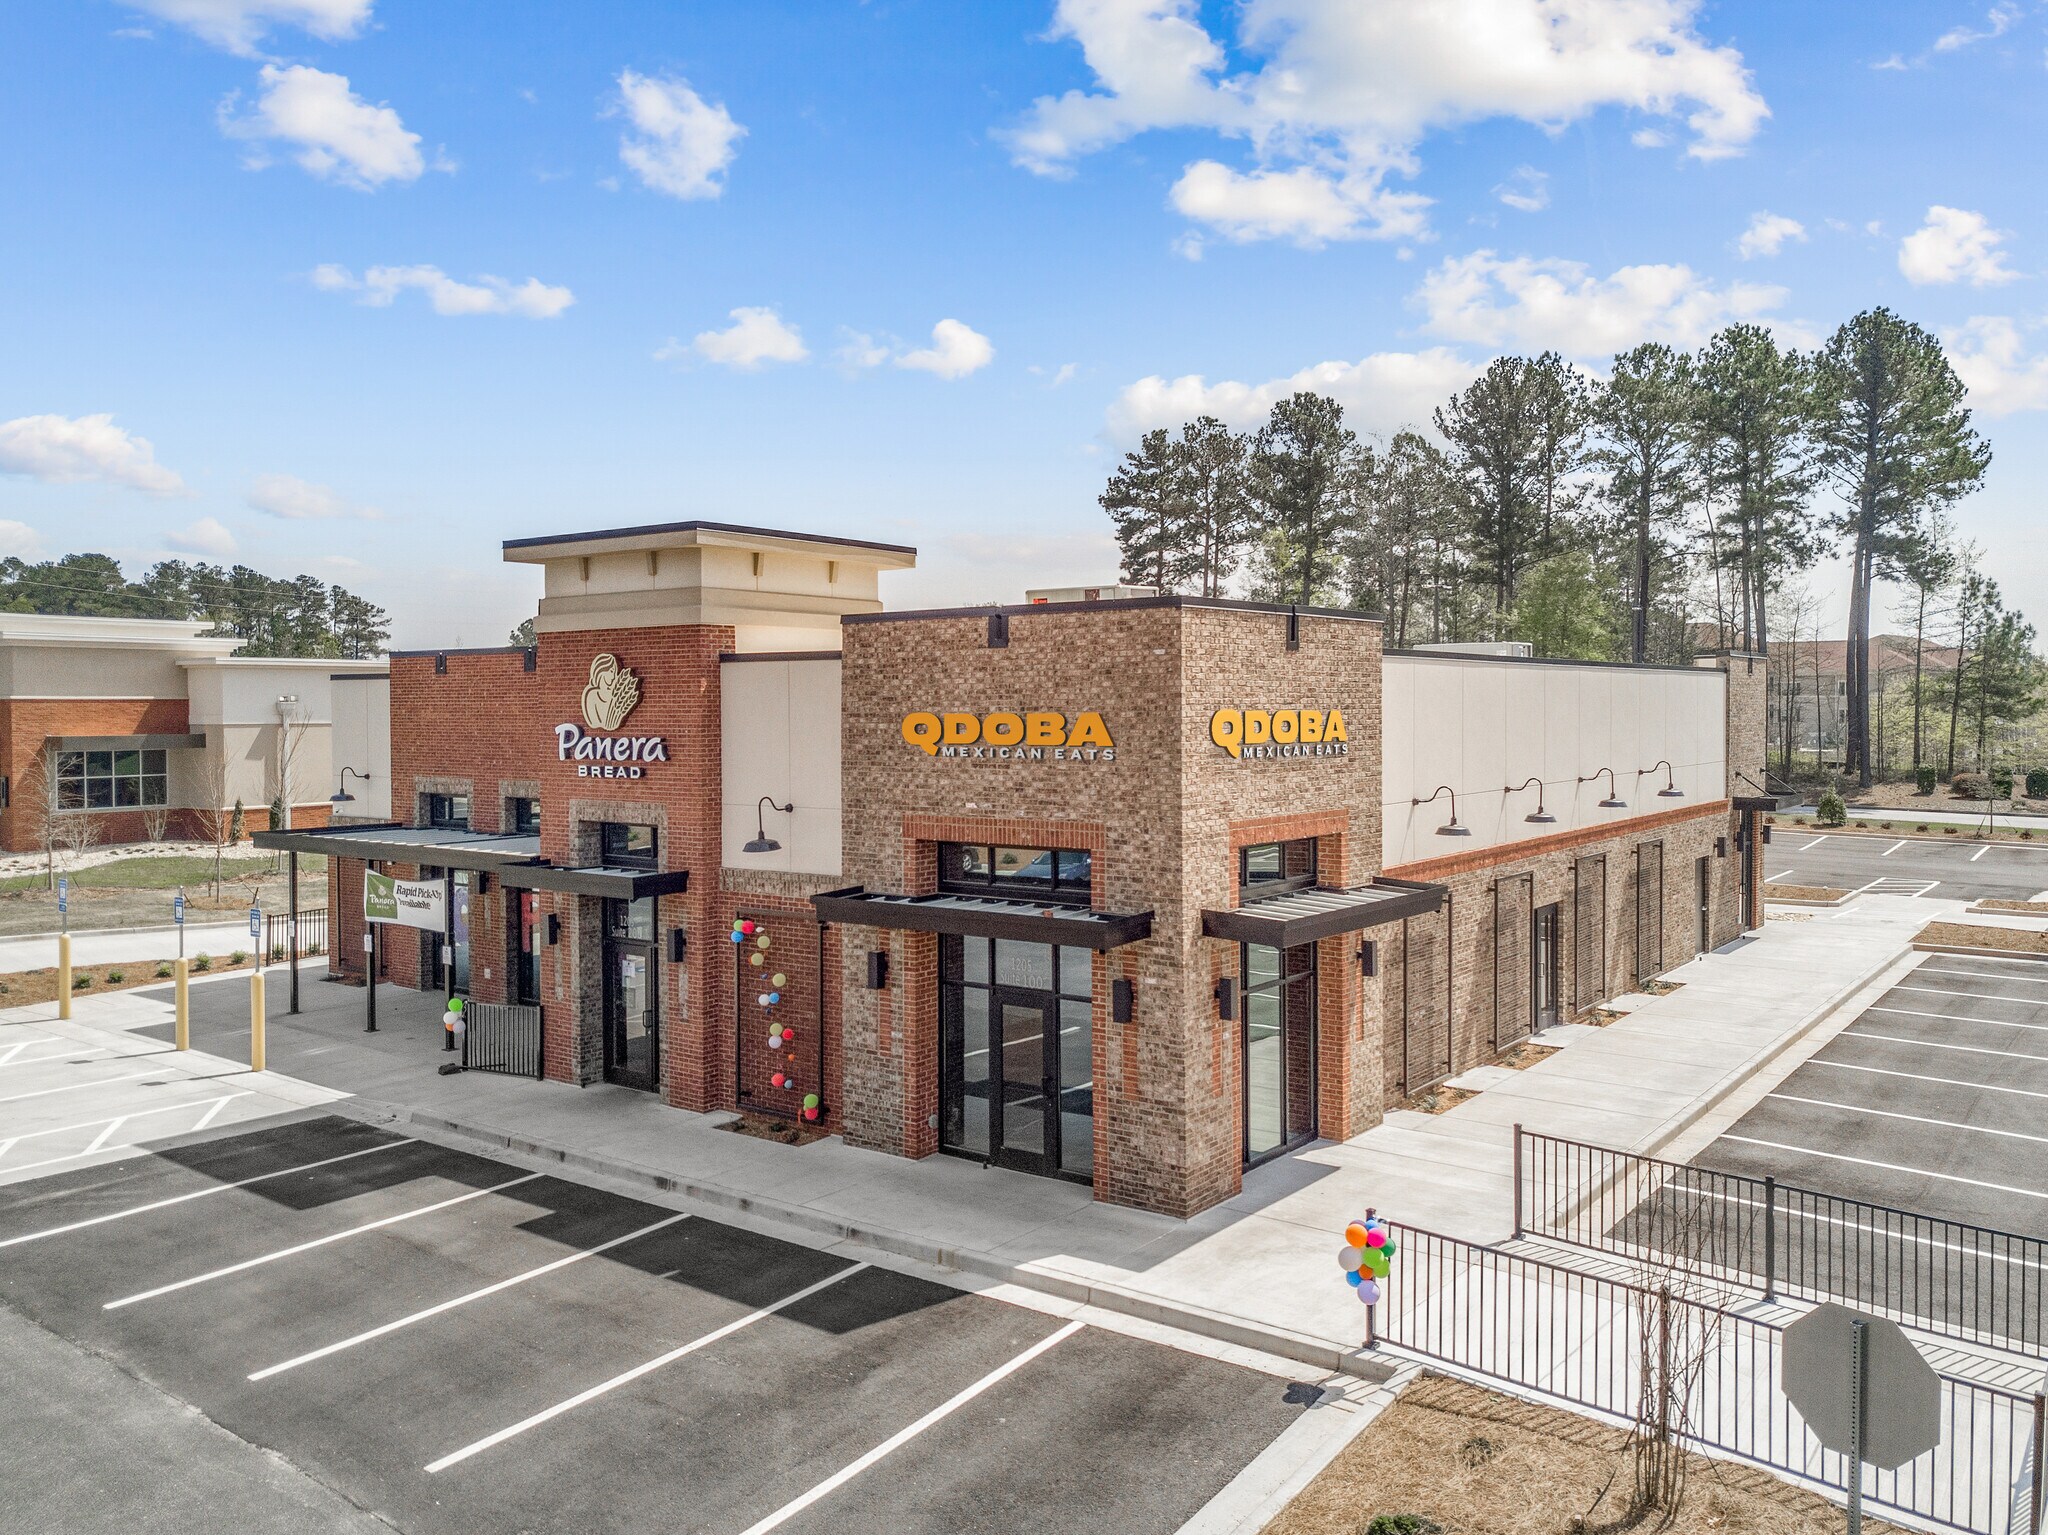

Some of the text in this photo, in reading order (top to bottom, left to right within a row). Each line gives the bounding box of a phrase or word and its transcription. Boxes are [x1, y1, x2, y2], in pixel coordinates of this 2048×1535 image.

[901, 712, 1115, 756] QDOBA
[1210, 709, 1348, 759] QDOBA
[555, 723, 667, 762] Panera
[942, 747, 1115, 761] MEXICAN EATS
[1243, 743, 1348, 758] MEXICAN EATS
[578, 765, 641, 779] BREAD
[396, 884, 417, 898] Rapid
[369, 894, 395, 905] Panera
[1012, 957, 1032, 971] 1205
[1023, 975, 1043, 989] 100
